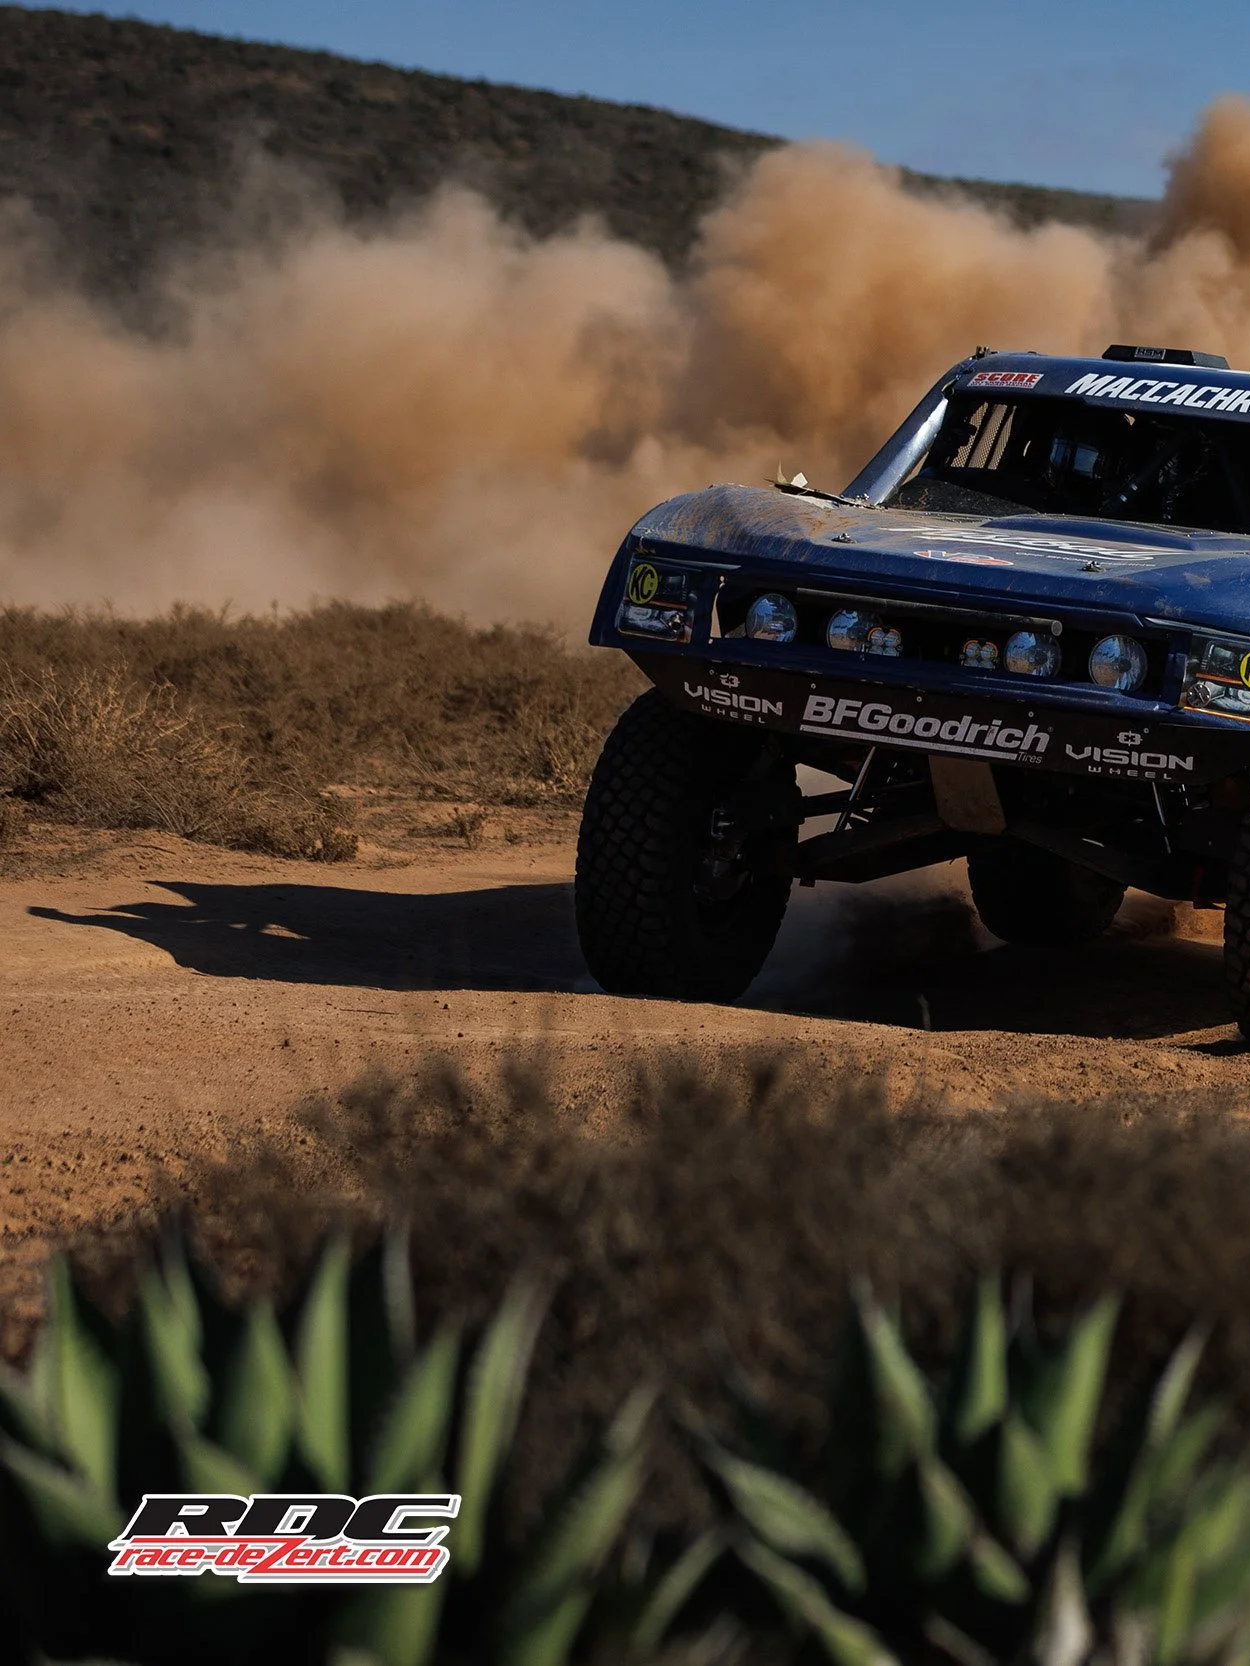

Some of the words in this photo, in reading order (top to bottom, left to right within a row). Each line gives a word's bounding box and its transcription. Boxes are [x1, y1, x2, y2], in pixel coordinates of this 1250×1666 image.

[973, 373, 1041, 384] SCORE
[631, 566, 656, 602] KC
[684, 681, 783, 717] VISION
[701, 703, 766, 724] WHEEL
[803, 694, 1051, 753] BFGoodrich
[1017, 751, 1043, 765] Tires
[1065, 743, 1194, 771] VISION
[1087, 765, 1172, 781] WHEEL
